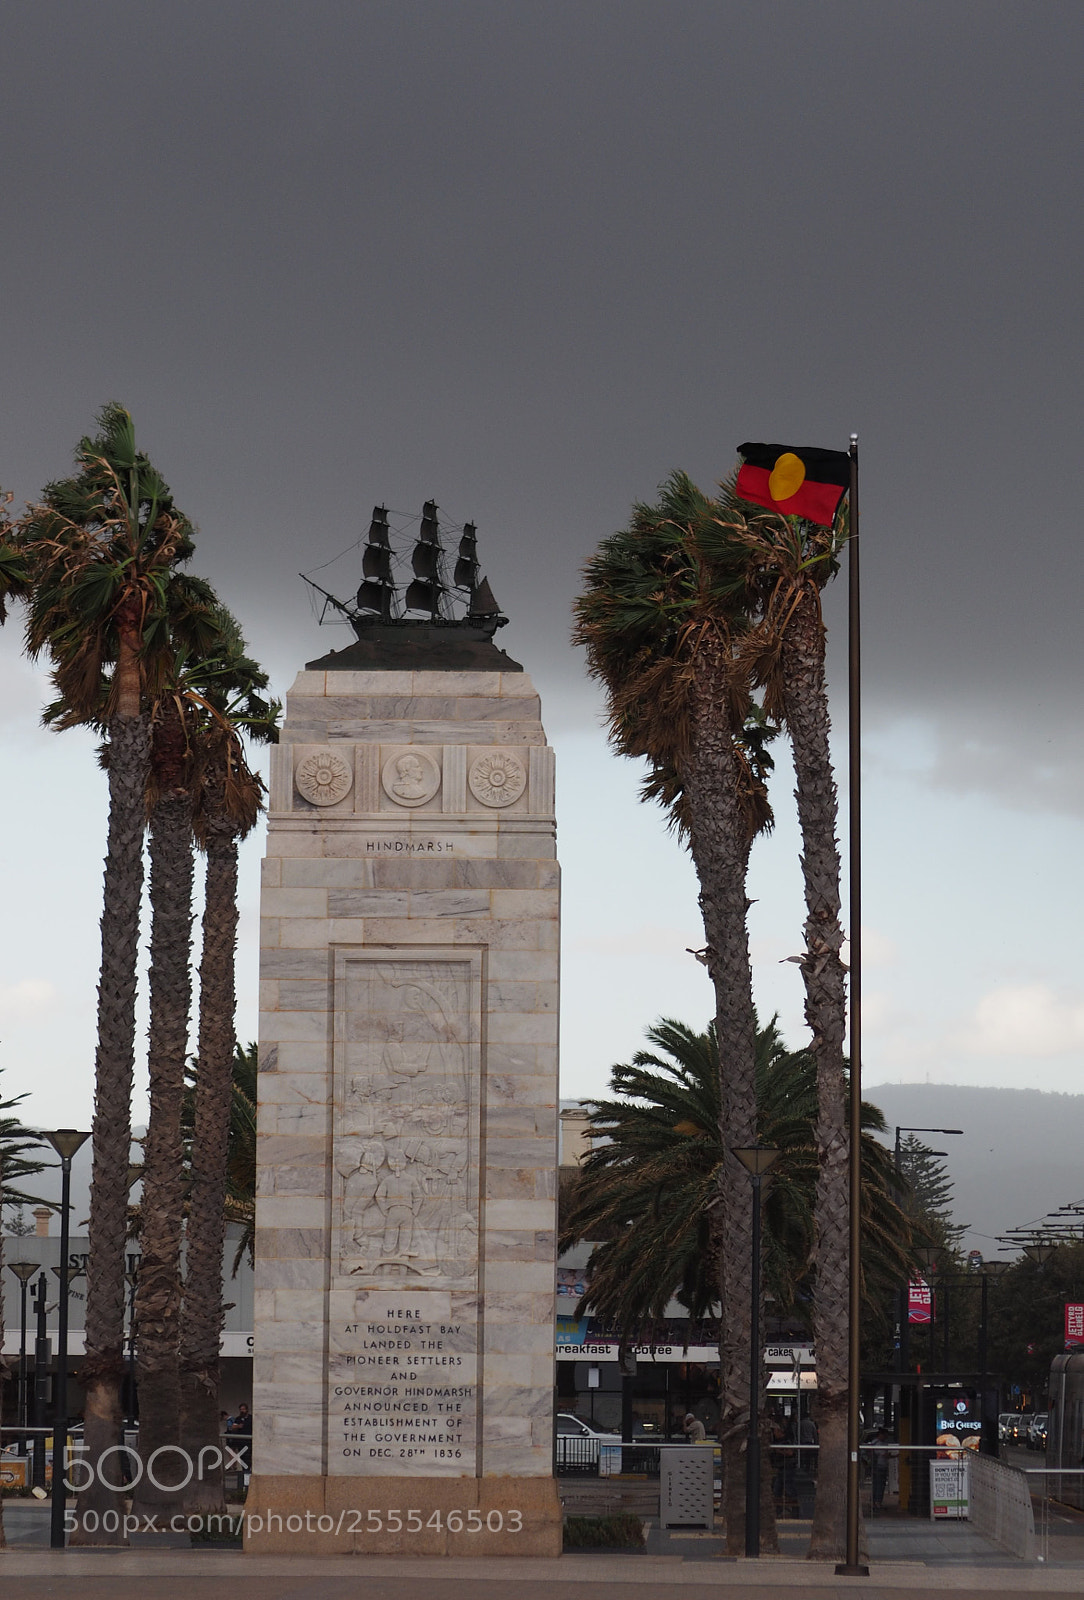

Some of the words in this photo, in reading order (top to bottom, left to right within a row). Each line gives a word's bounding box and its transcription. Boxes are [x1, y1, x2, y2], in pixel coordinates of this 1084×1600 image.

[366, 840, 454, 853] HINDMARSH
[387, 1310, 421, 1319] HERE
[345, 1325, 358, 1334] AT
[367, 1325, 432, 1334] HOLDFAST
[440, 1325, 462, 1334] BAY
[363, 1340, 411, 1350] LANDED
[420, 1340, 443, 1350] THE
[768, 1347, 794, 1357] cakes
[346, 1356, 400, 1365] PIONEER
[407, 1356, 462, 1366] SETTLERS
[390, 1372, 418, 1381] AND
[334, 1387, 399, 1396] GOVERNOR
[405, 1387, 472, 1396] HINDMARSH
[344, 1403, 429, 1412] ANNOUNCED
[437, 1403, 462, 1412] THE
[343, 1418, 438, 1428] ESTABLISHMENT
[446, 1418, 463, 1428] OF
[343, 1433, 366, 1442] THE
[375, 1433, 463, 1443] GOVERNMENT
[343, 1448, 361, 1457] ON
[369, 1448, 394, 1458] DEC.
[434, 1448, 462, 1458] 1836
